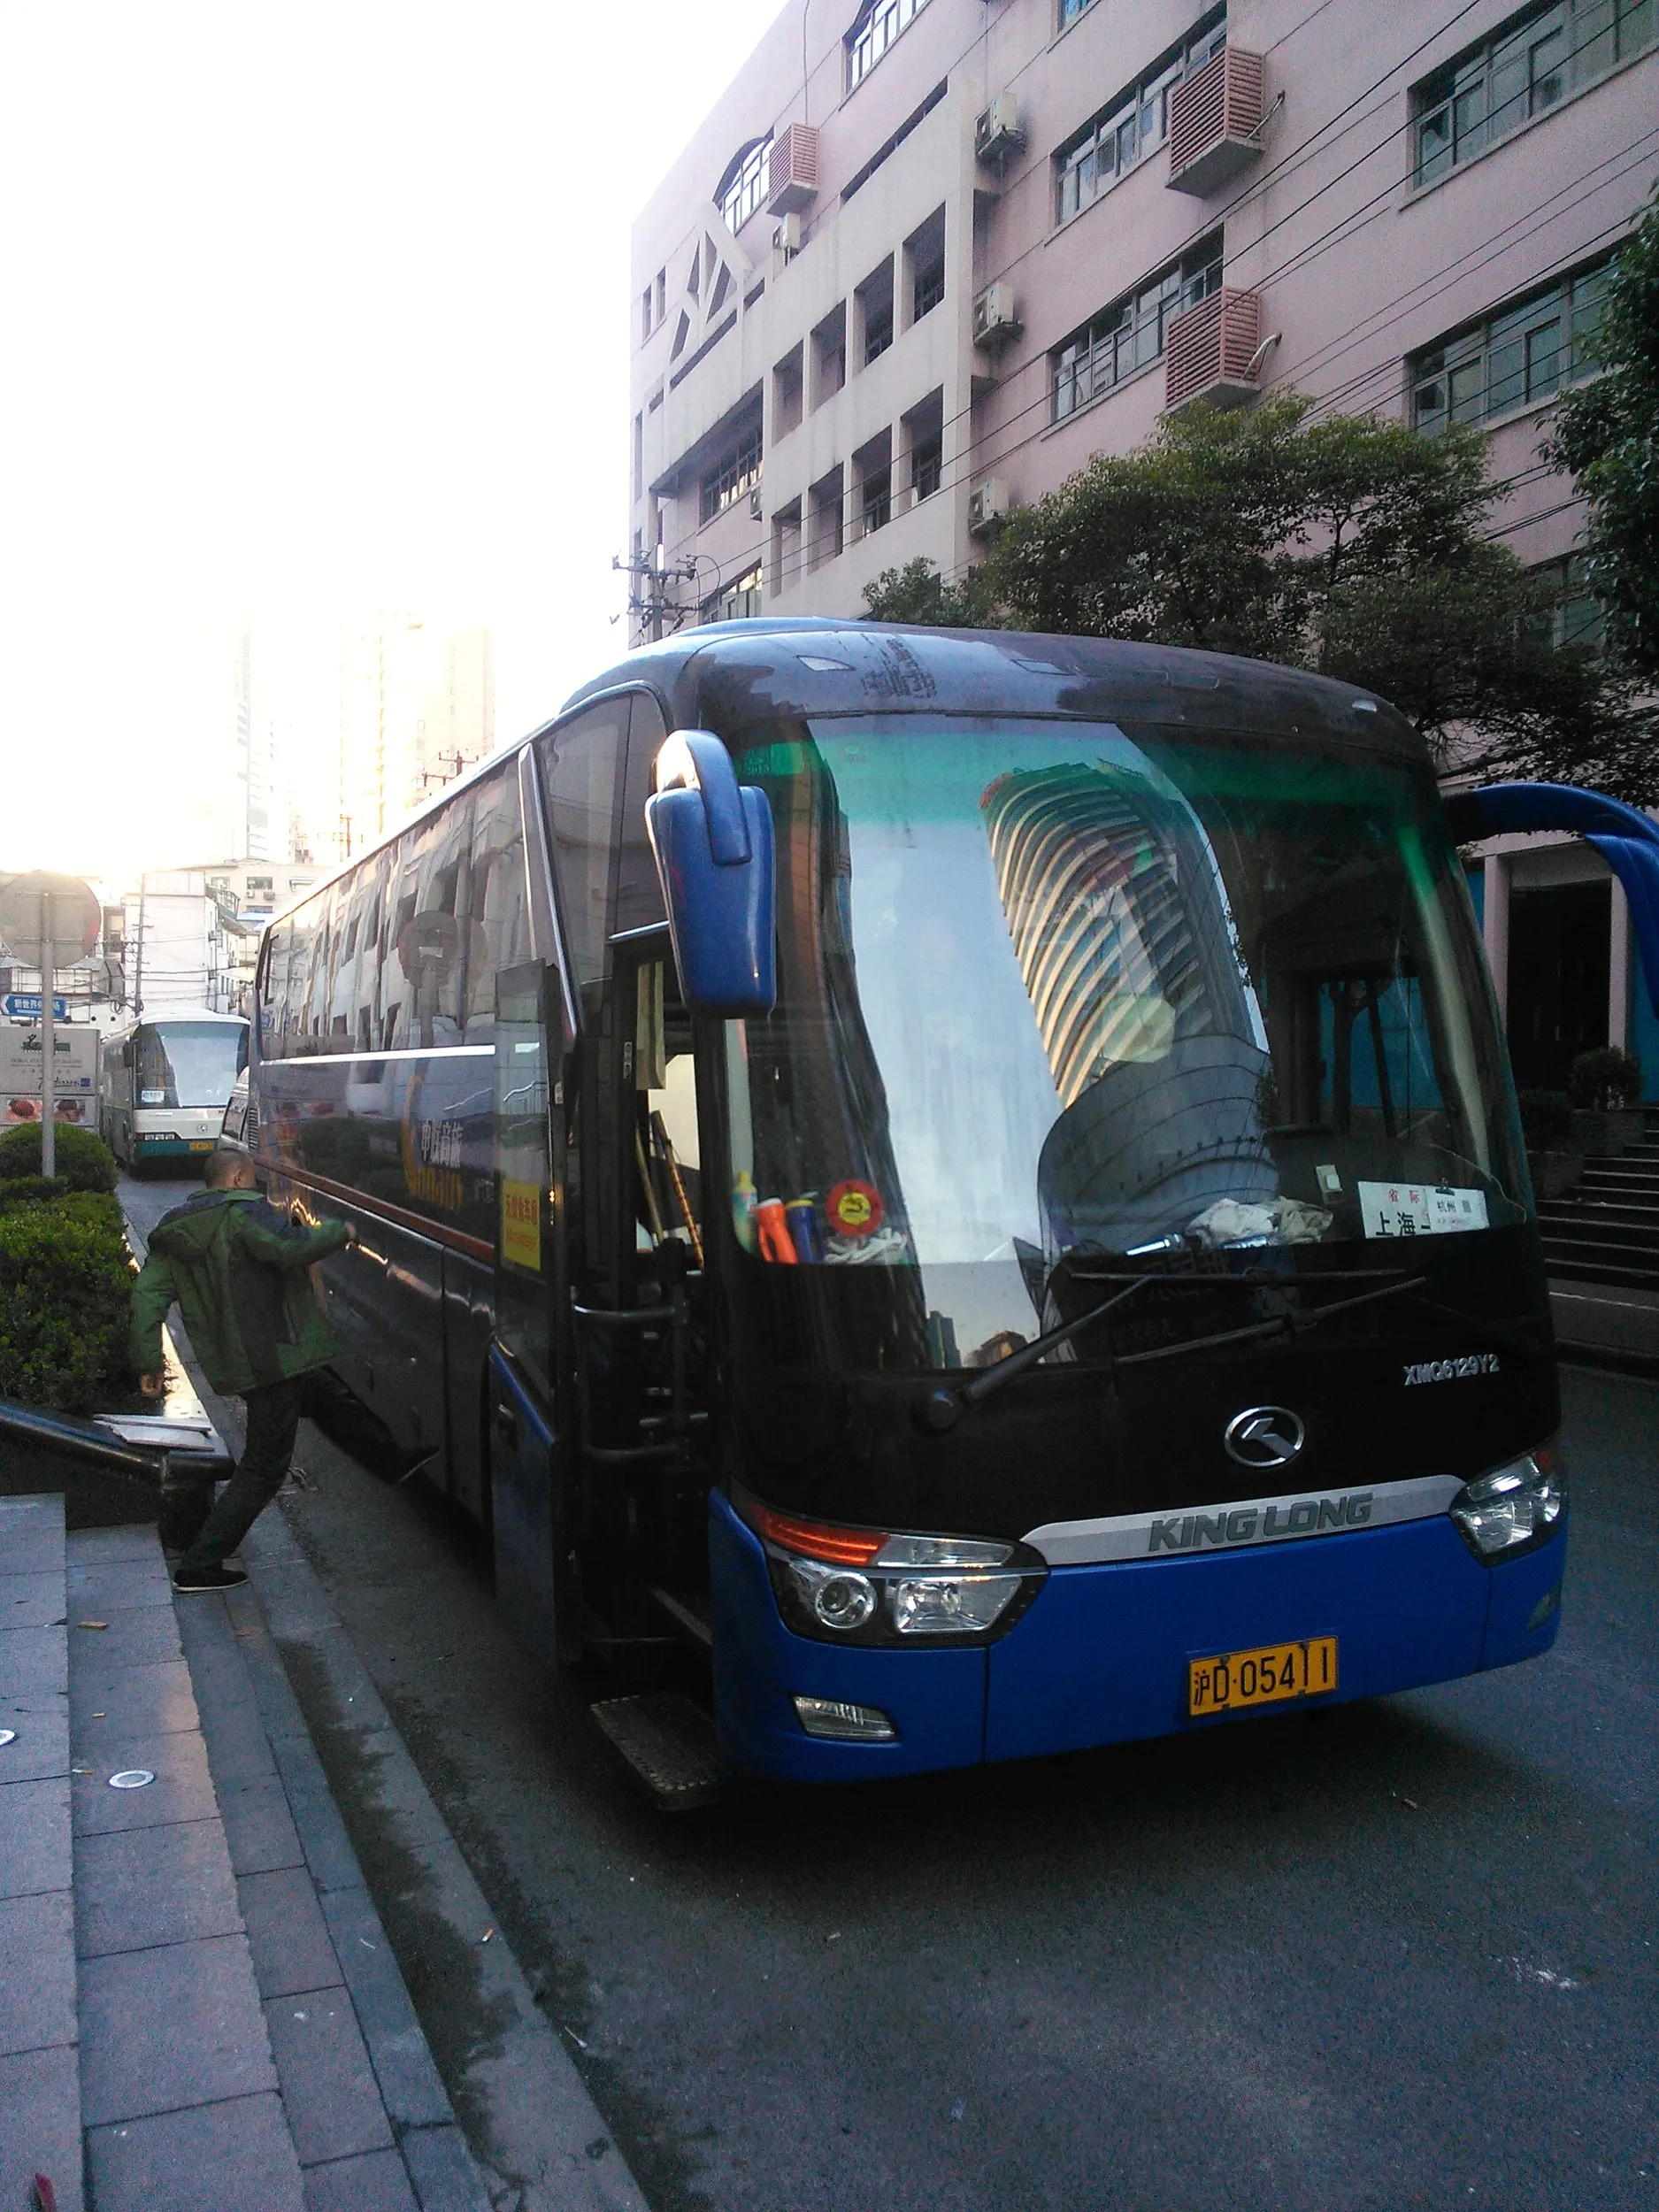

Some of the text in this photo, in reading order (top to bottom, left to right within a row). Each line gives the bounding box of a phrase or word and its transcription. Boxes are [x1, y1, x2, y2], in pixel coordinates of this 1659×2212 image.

[1388, 1188, 1420, 1204] 省际
[1403, 1354, 1501, 1386] XMQ6129Y2
[1148, 1492, 1373, 1552] KING LONG
